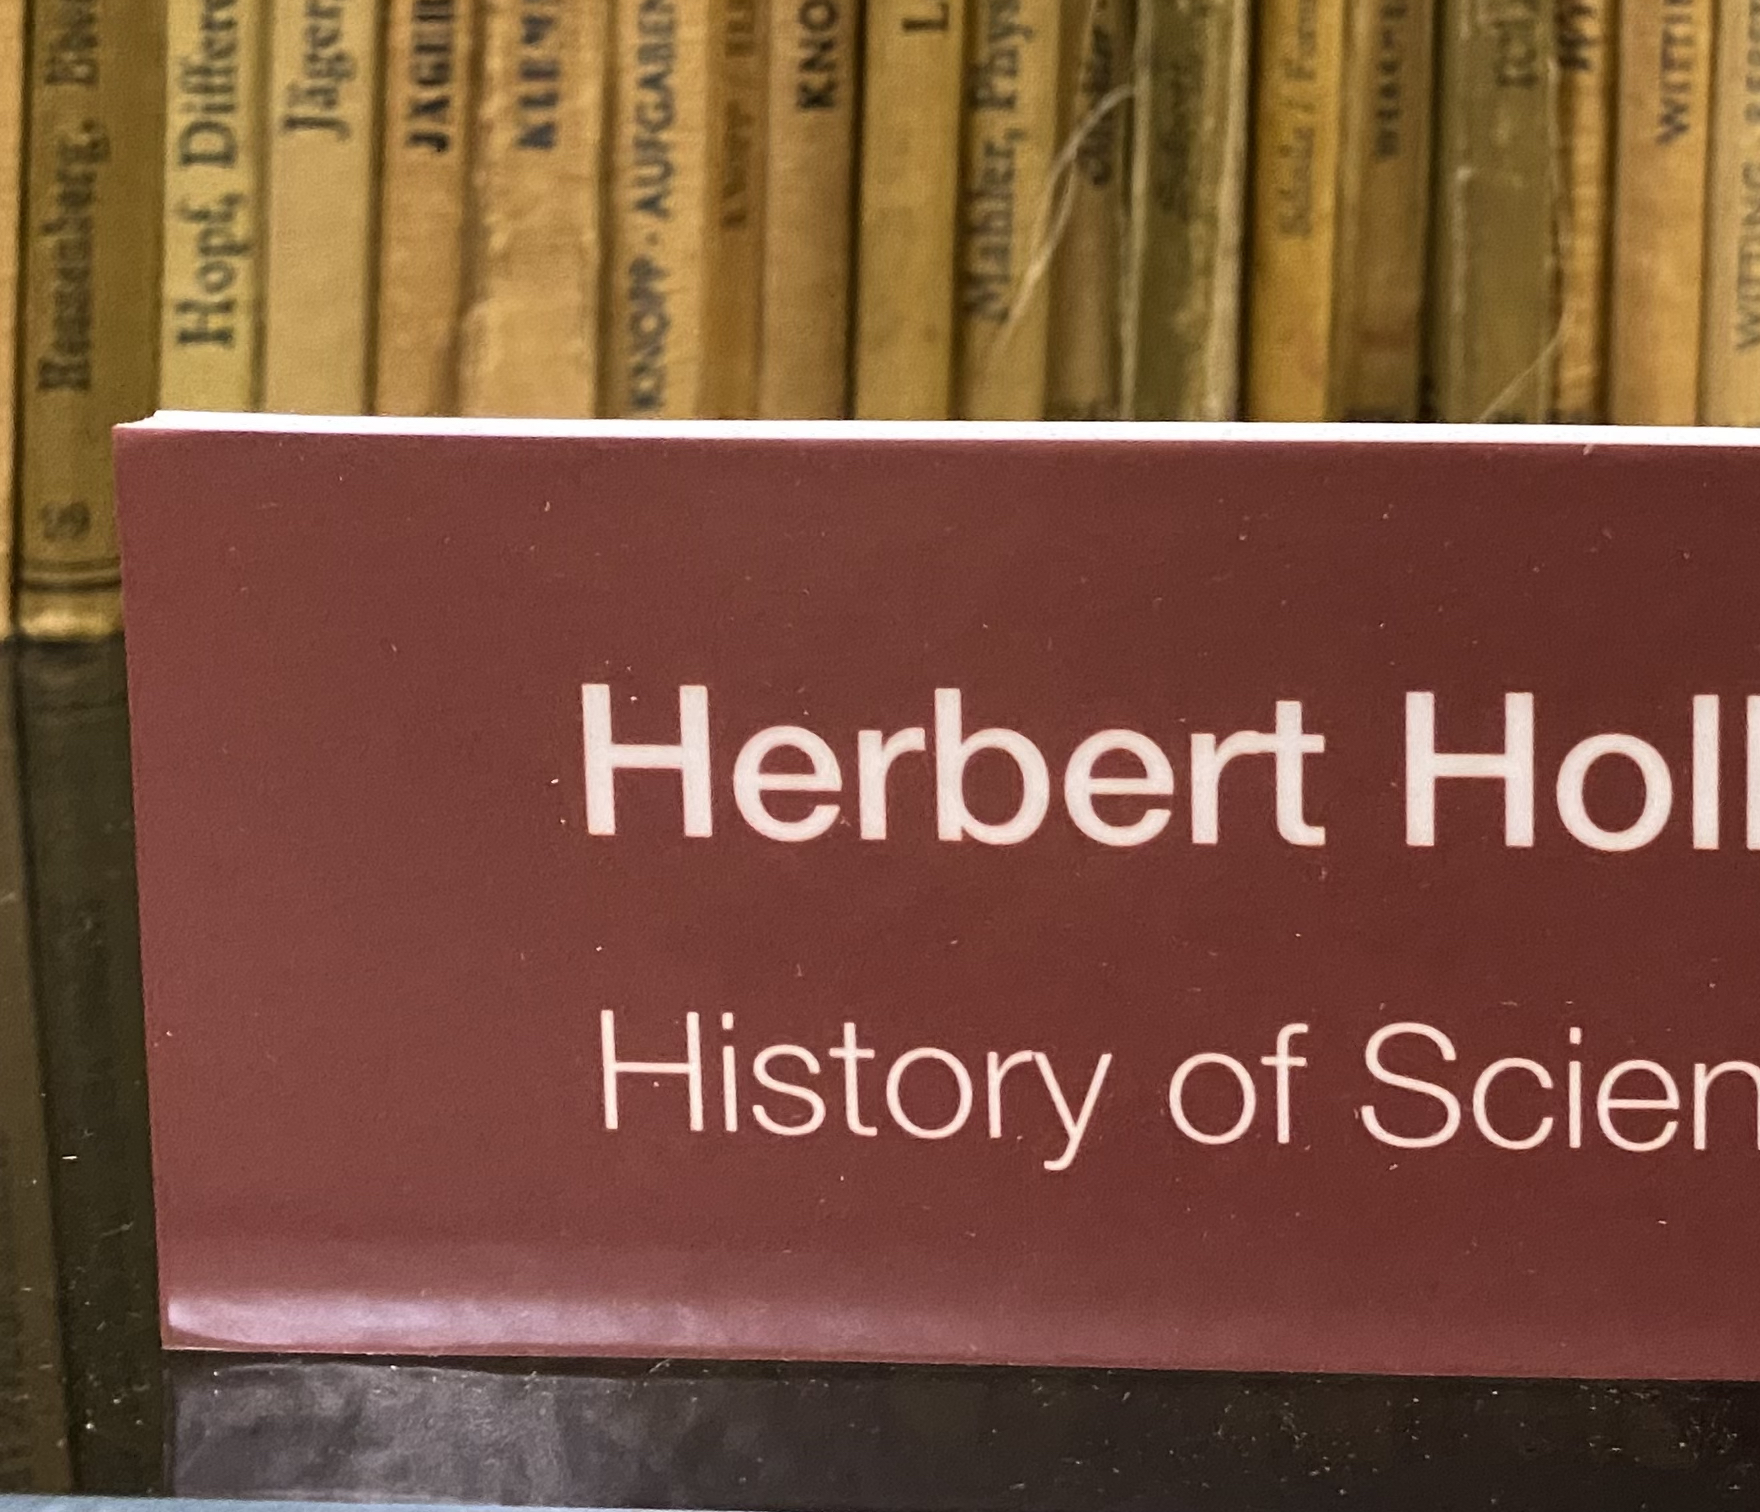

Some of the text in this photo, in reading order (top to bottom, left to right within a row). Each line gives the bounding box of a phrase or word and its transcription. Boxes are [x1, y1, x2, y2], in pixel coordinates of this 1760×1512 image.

[176, 192, 250, 350] Hopf,
[581, 683, 1326, 848] Herbert
[600, 1010, 1112, 1172] History
[1168, 1024, 1308, 1146] of
